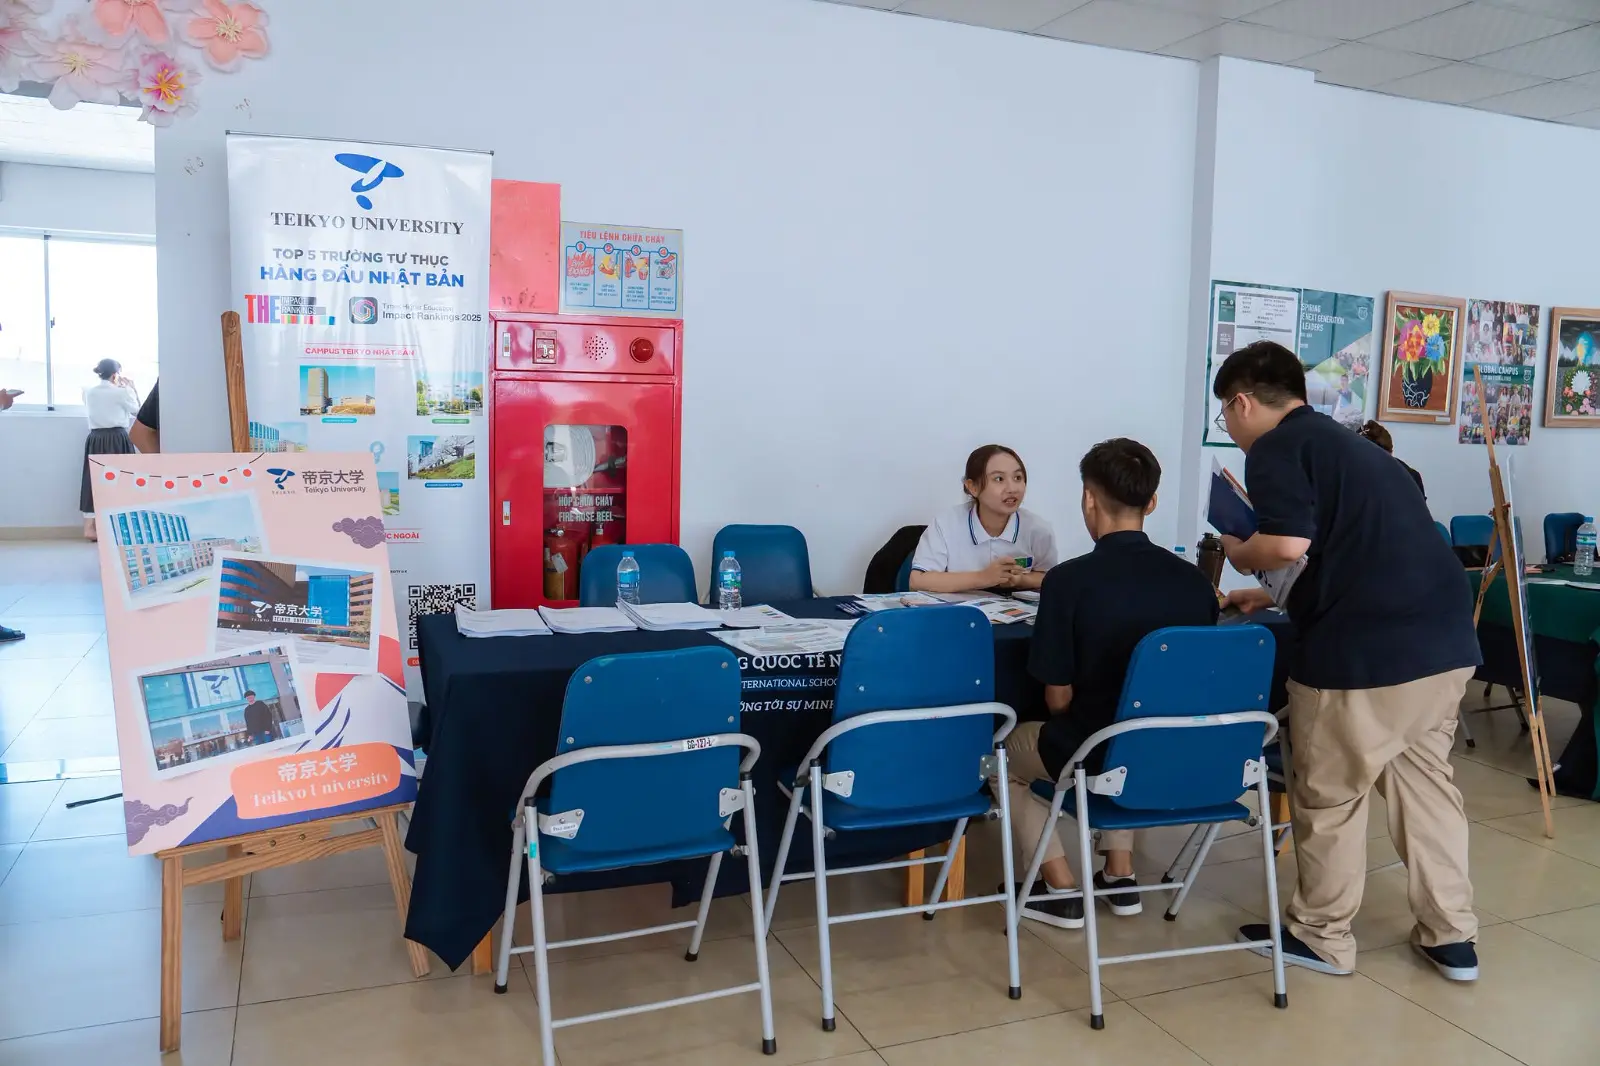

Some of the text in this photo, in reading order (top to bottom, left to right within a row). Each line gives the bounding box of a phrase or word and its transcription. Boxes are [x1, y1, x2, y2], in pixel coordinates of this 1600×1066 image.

[270, 212, 464, 235] TEIKYO UNIVERSITY
[273, 248, 449, 268] TOP 5 TRƯỜNG TƯ THỤC
[260, 263, 464, 288] HÀNG ĐẦU NHẬT BẢN
[244, 294, 281, 324] THE
[382, 311, 482, 323] Impact Rankings 2025
[302, 470, 365, 484] 帝京大学
[304, 485, 366, 494] Teikyo University
[559, 511, 613, 522] FIRE HOSE REEL
[274, 603, 322, 617] 帝京大学
[741, 678, 837, 689] TERNATIONAL SCHO
[277, 752, 358, 783] 帝京大学
